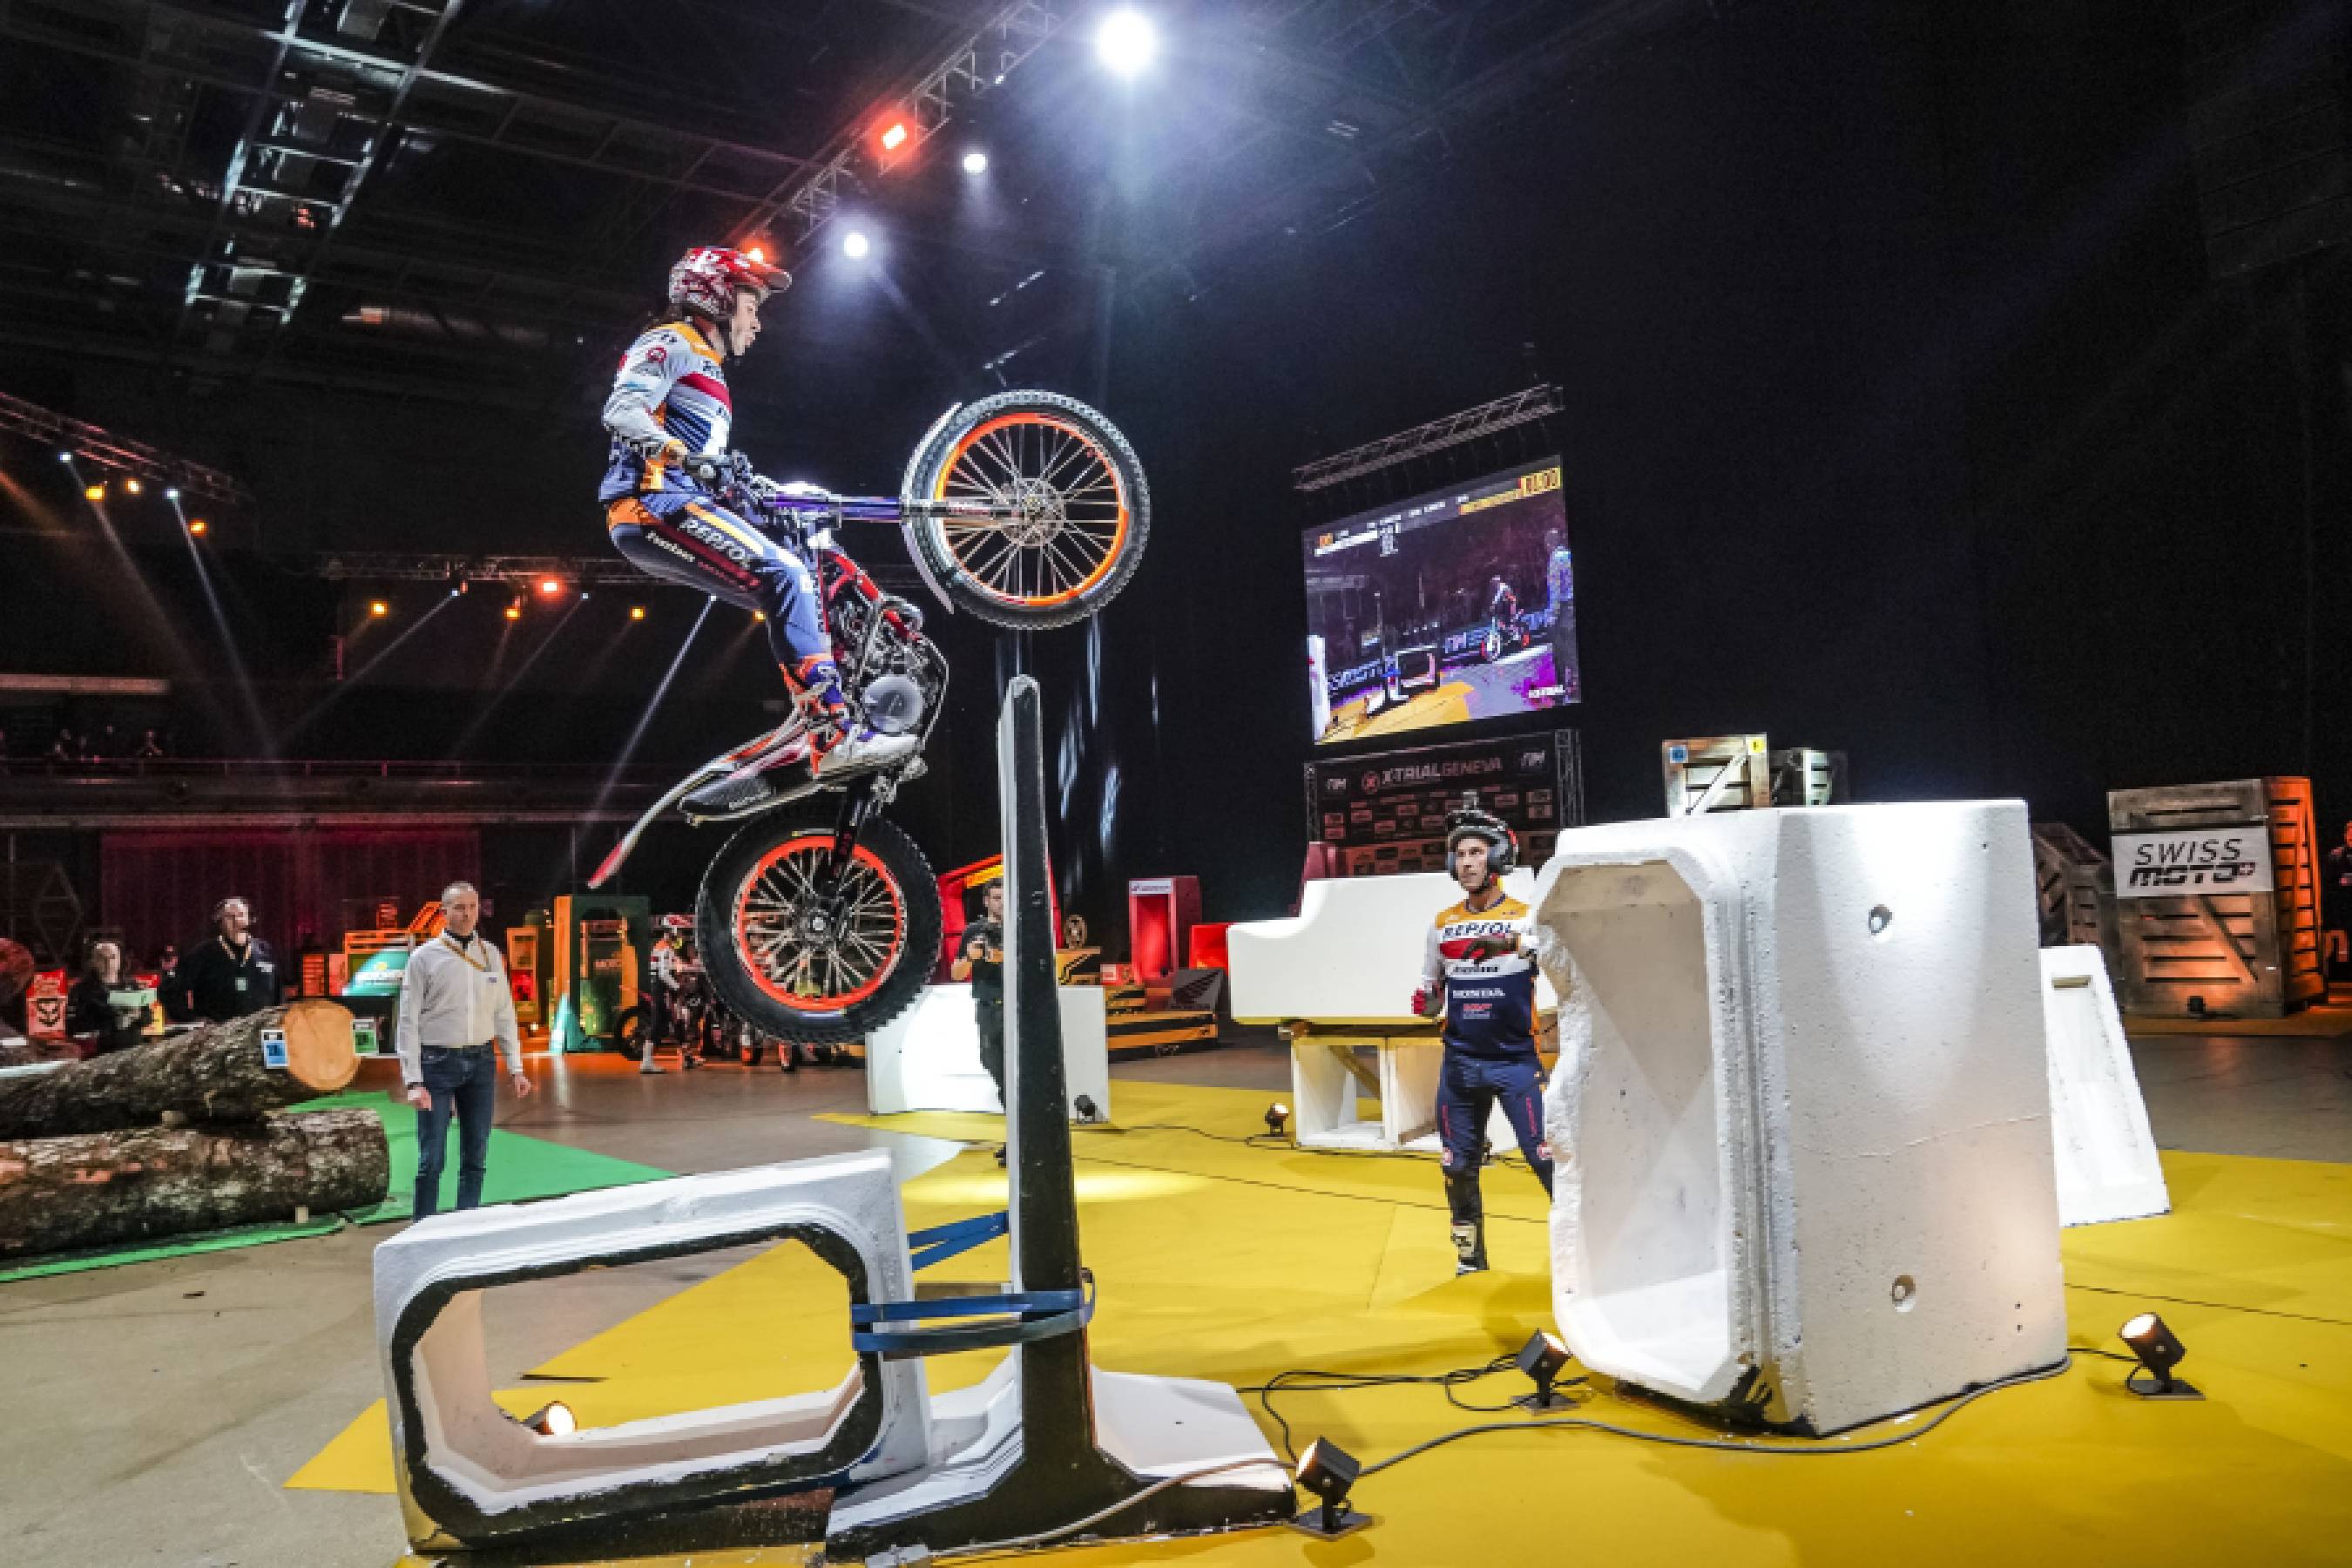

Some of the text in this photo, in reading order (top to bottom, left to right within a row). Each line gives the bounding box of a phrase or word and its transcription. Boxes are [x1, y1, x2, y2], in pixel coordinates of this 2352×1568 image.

[2135, 838, 2243, 866] SWISS
[2129, 863, 2240, 887] MOTO
[1443, 922, 1513, 939] REPSOL
[1453, 989, 1505, 998] HONDA
